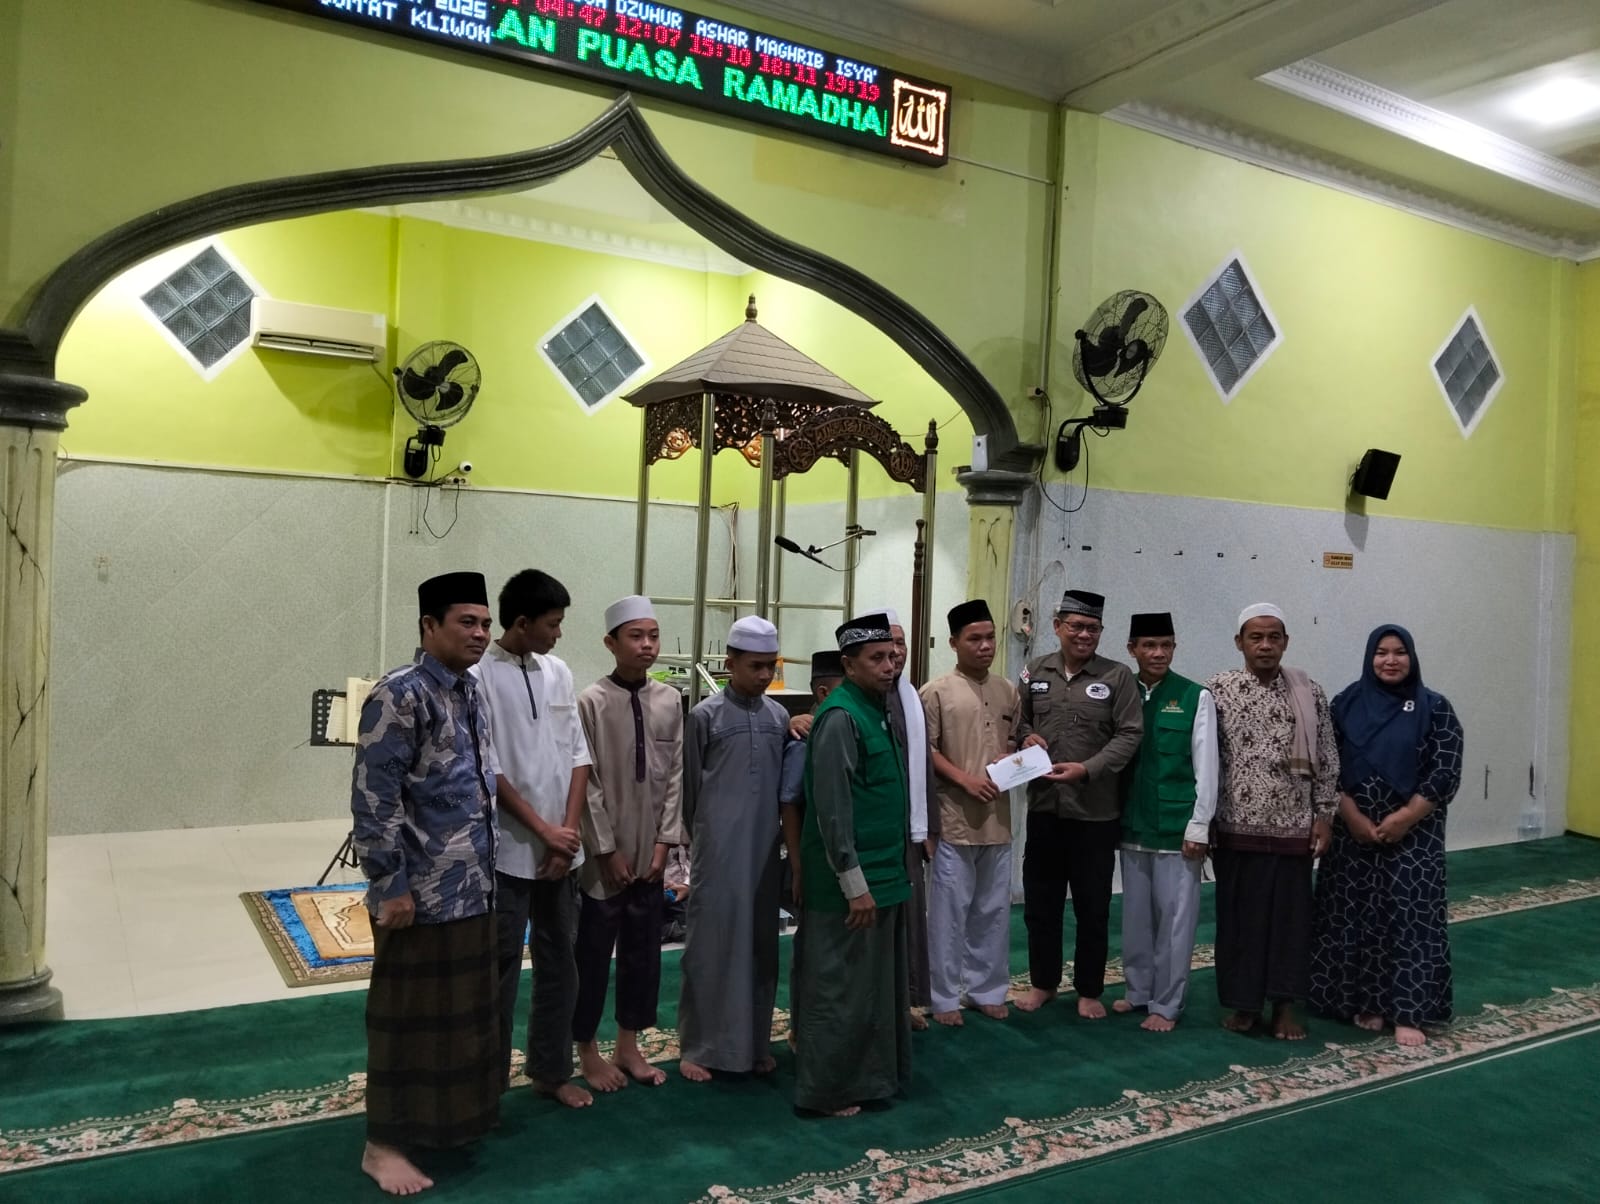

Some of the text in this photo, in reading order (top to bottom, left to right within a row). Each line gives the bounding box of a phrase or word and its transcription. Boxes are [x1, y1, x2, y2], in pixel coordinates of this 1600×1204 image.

[410, 8, 491, 45] KLIWON
[535, 0, 881, 102] 04:47 12:07 15:10 18:11 19:19
[615, 0, 878, 84] DZUHUR ASHAR MAGHRIB ISYA'
[577, 28, 704, 91] PUASA
[723, 66, 888, 138] RAMADHA
